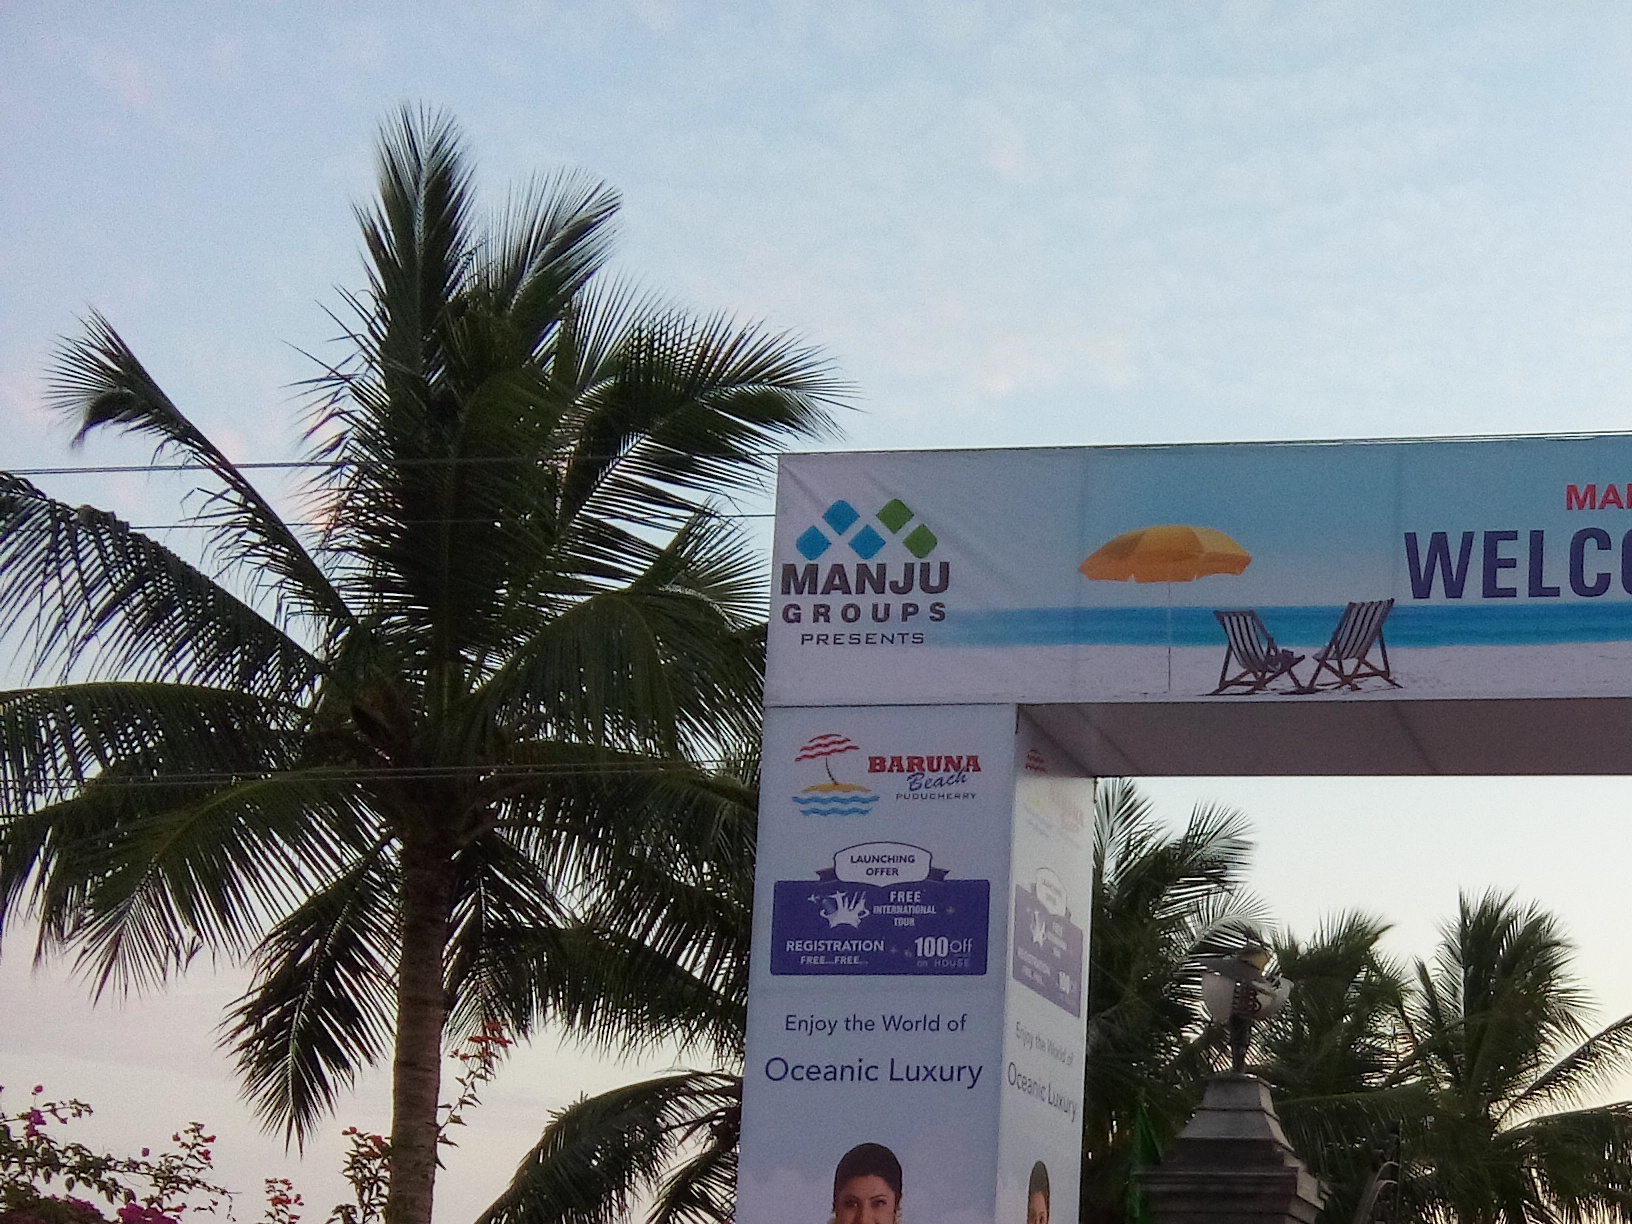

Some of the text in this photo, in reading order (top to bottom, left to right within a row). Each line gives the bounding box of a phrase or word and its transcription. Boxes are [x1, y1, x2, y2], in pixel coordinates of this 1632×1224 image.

[780, 561, 950, 595] MANJU
[782, 602, 946, 624] GROUPS
[801, 632, 925, 645] PRESENTS
[867, 755, 982, 773] BARUNA
[906, 767, 967, 792] Beach
[896, 792, 977, 801] PUDUCHERRY
[850, 854, 916, 865] LAUNCHING
[865, 867, 900, 878] OFFER
[889, 890, 922, 902] FREE
[872, 905, 937, 915] INTERNATIONAL
[893, 917, 916, 927] TOUR
[785, 939, 885, 952] REGISTRATION
[934, 958, 970, 967] HOUSE
[784, 1013, 967, 1036] Enjoy the World of
[764, 1057, 983, 1090] Oceanic Luxury
